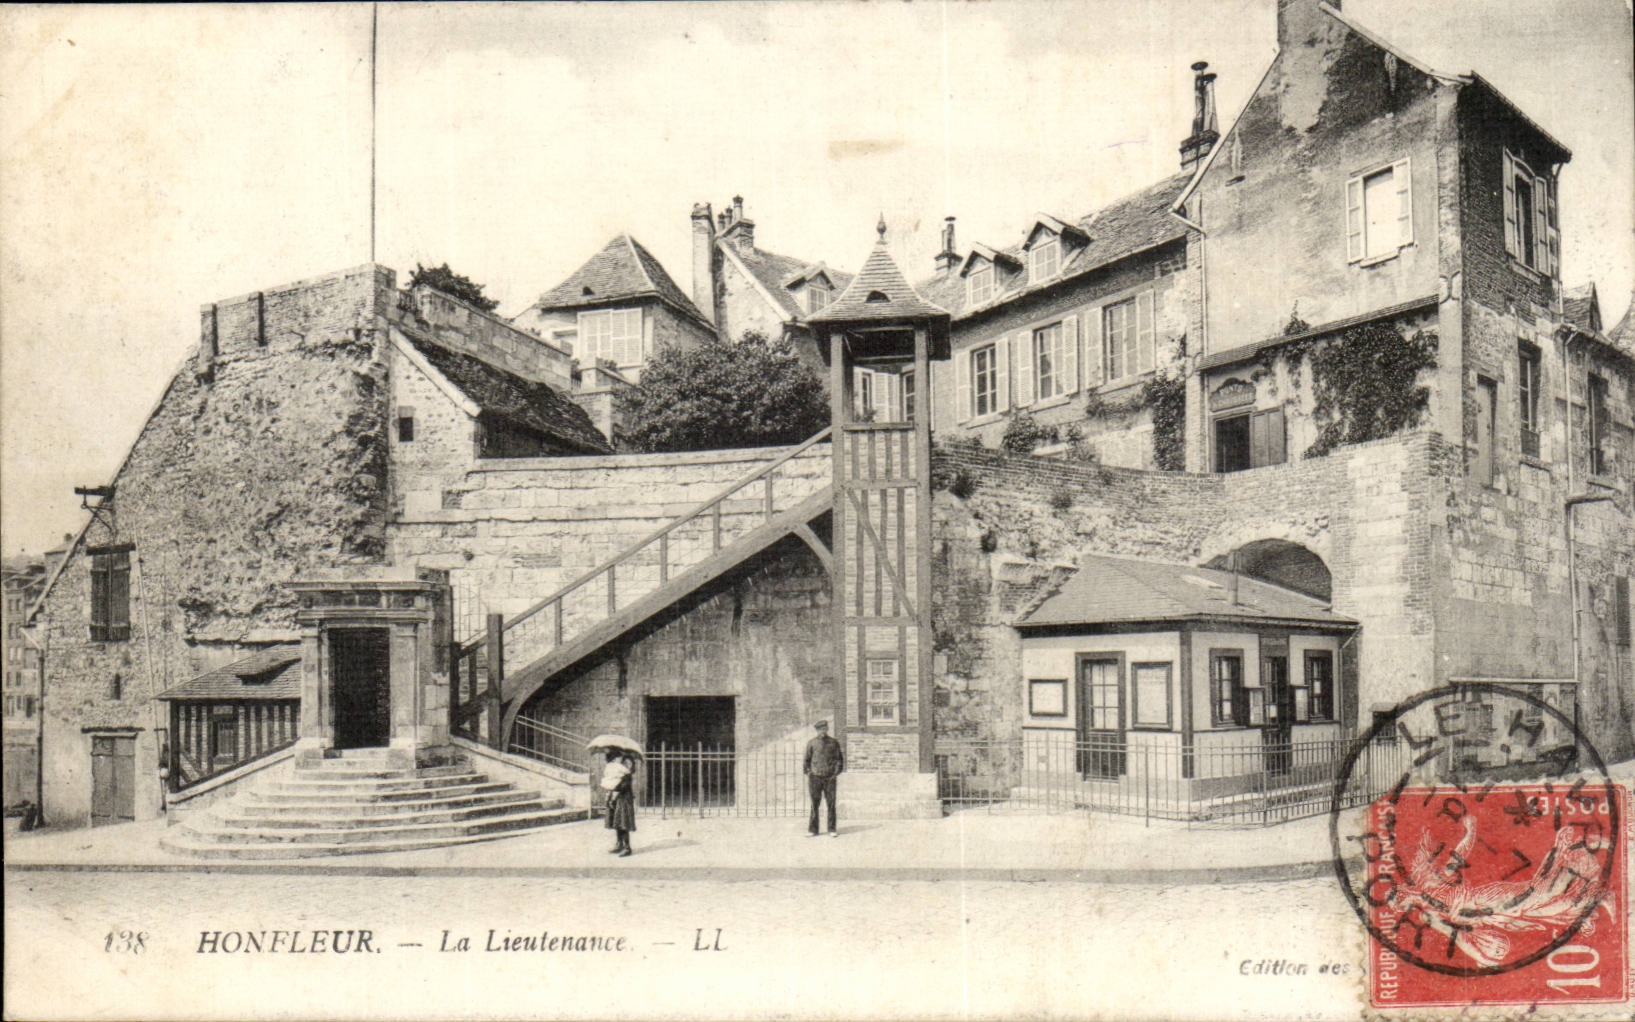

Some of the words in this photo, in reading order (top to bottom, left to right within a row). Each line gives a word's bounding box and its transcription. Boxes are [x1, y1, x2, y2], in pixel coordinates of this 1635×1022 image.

[1525, 795, 1610, 816] POSTES
[1378, 911, 1399, 1000] REPUBQUE
[1546, 944, 1601, 996] 10
